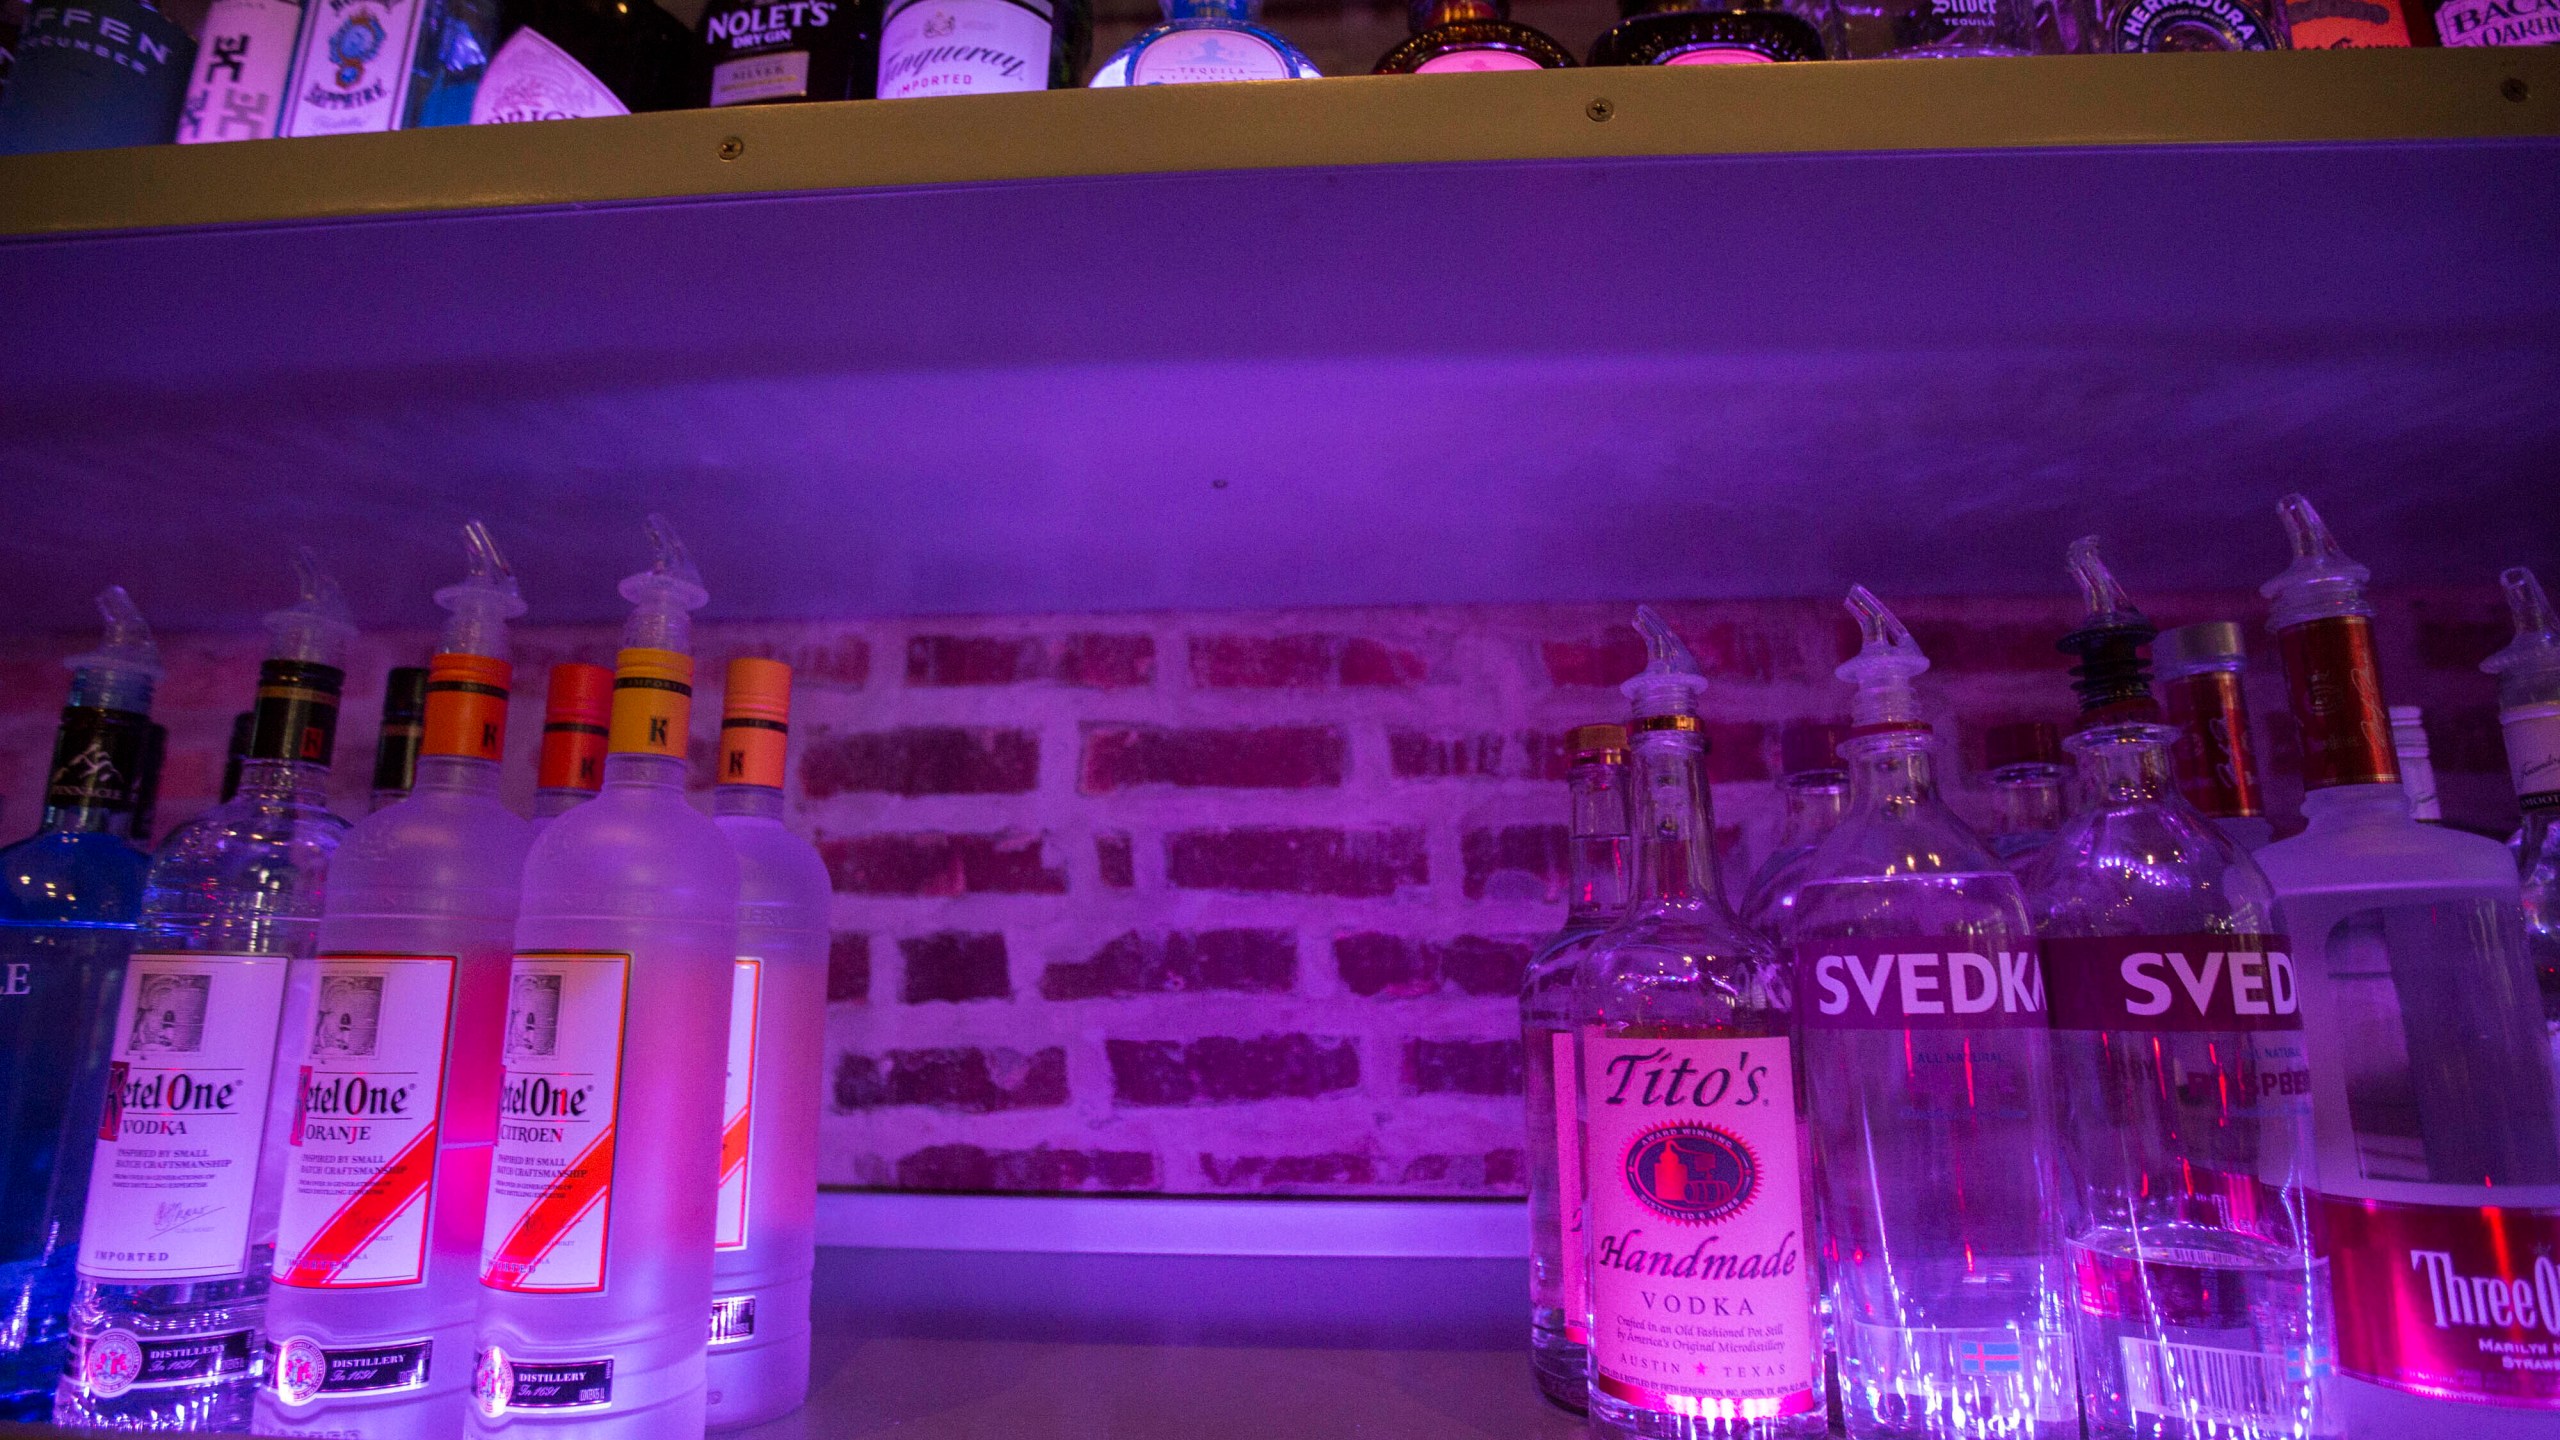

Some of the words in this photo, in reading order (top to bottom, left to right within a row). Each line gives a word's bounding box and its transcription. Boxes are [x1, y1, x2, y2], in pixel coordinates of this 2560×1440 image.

[706, 0, 829, 45] NOLET'S
[1943, 18, 1996, 26] TEQUILA
[732, 34, 761, 49] DRY
[763, 29, 792, 44] GIN
[1181, 67, 1245, 75] TEQUILA
[650, 717, 668, 746] K
[729, 752, 745, 776] K
[1606, 1047, 1768, 1107] Tito's
[167, 1073, 234, 1111] One
[345, 1077, 408, 1115] One
[530, 1078, 586, 1116] One
[123, 1120, 188, 1136] VODKA
[306, 1124, 371, 1145] ORANJE
[501, 1125, 564, 1143] CITROEN
[1641, 1128, 1678, 1146] AWARD
[1681, 1128, 1733, 1147] WINNING
[173, 1150, 209, 1158] SMALL
[353, 1155, 386, 1163] SMALL
[1640, 1194, 1695, 1220] DISTILLED
[94, 1251, 169, 1262] IMPORTED
[1600, 1228, 1797, 1281] Handmade
[1641, 1290, 1754, 1316] VODKA
[1675, 1324, 1693, 1336] Old
[1697, 1327, 1744, 1338] Fashioned
[1747, 1327, 1762, 1337] Pot
[151, 1345, 226, 1359] DISTILLERY
[1672, 1339, 1714, 1356] Original
[2479, 1338, 2547, 1355] MARILYN
[333, 1354, 406, 1368] DISTILLERY
[1620, 1353, 1680, 1374] AUSTIN
[1723, 1363, 1786, 1378] TEXAS
[518, 1371, 587, 1383] DISTILLERY
